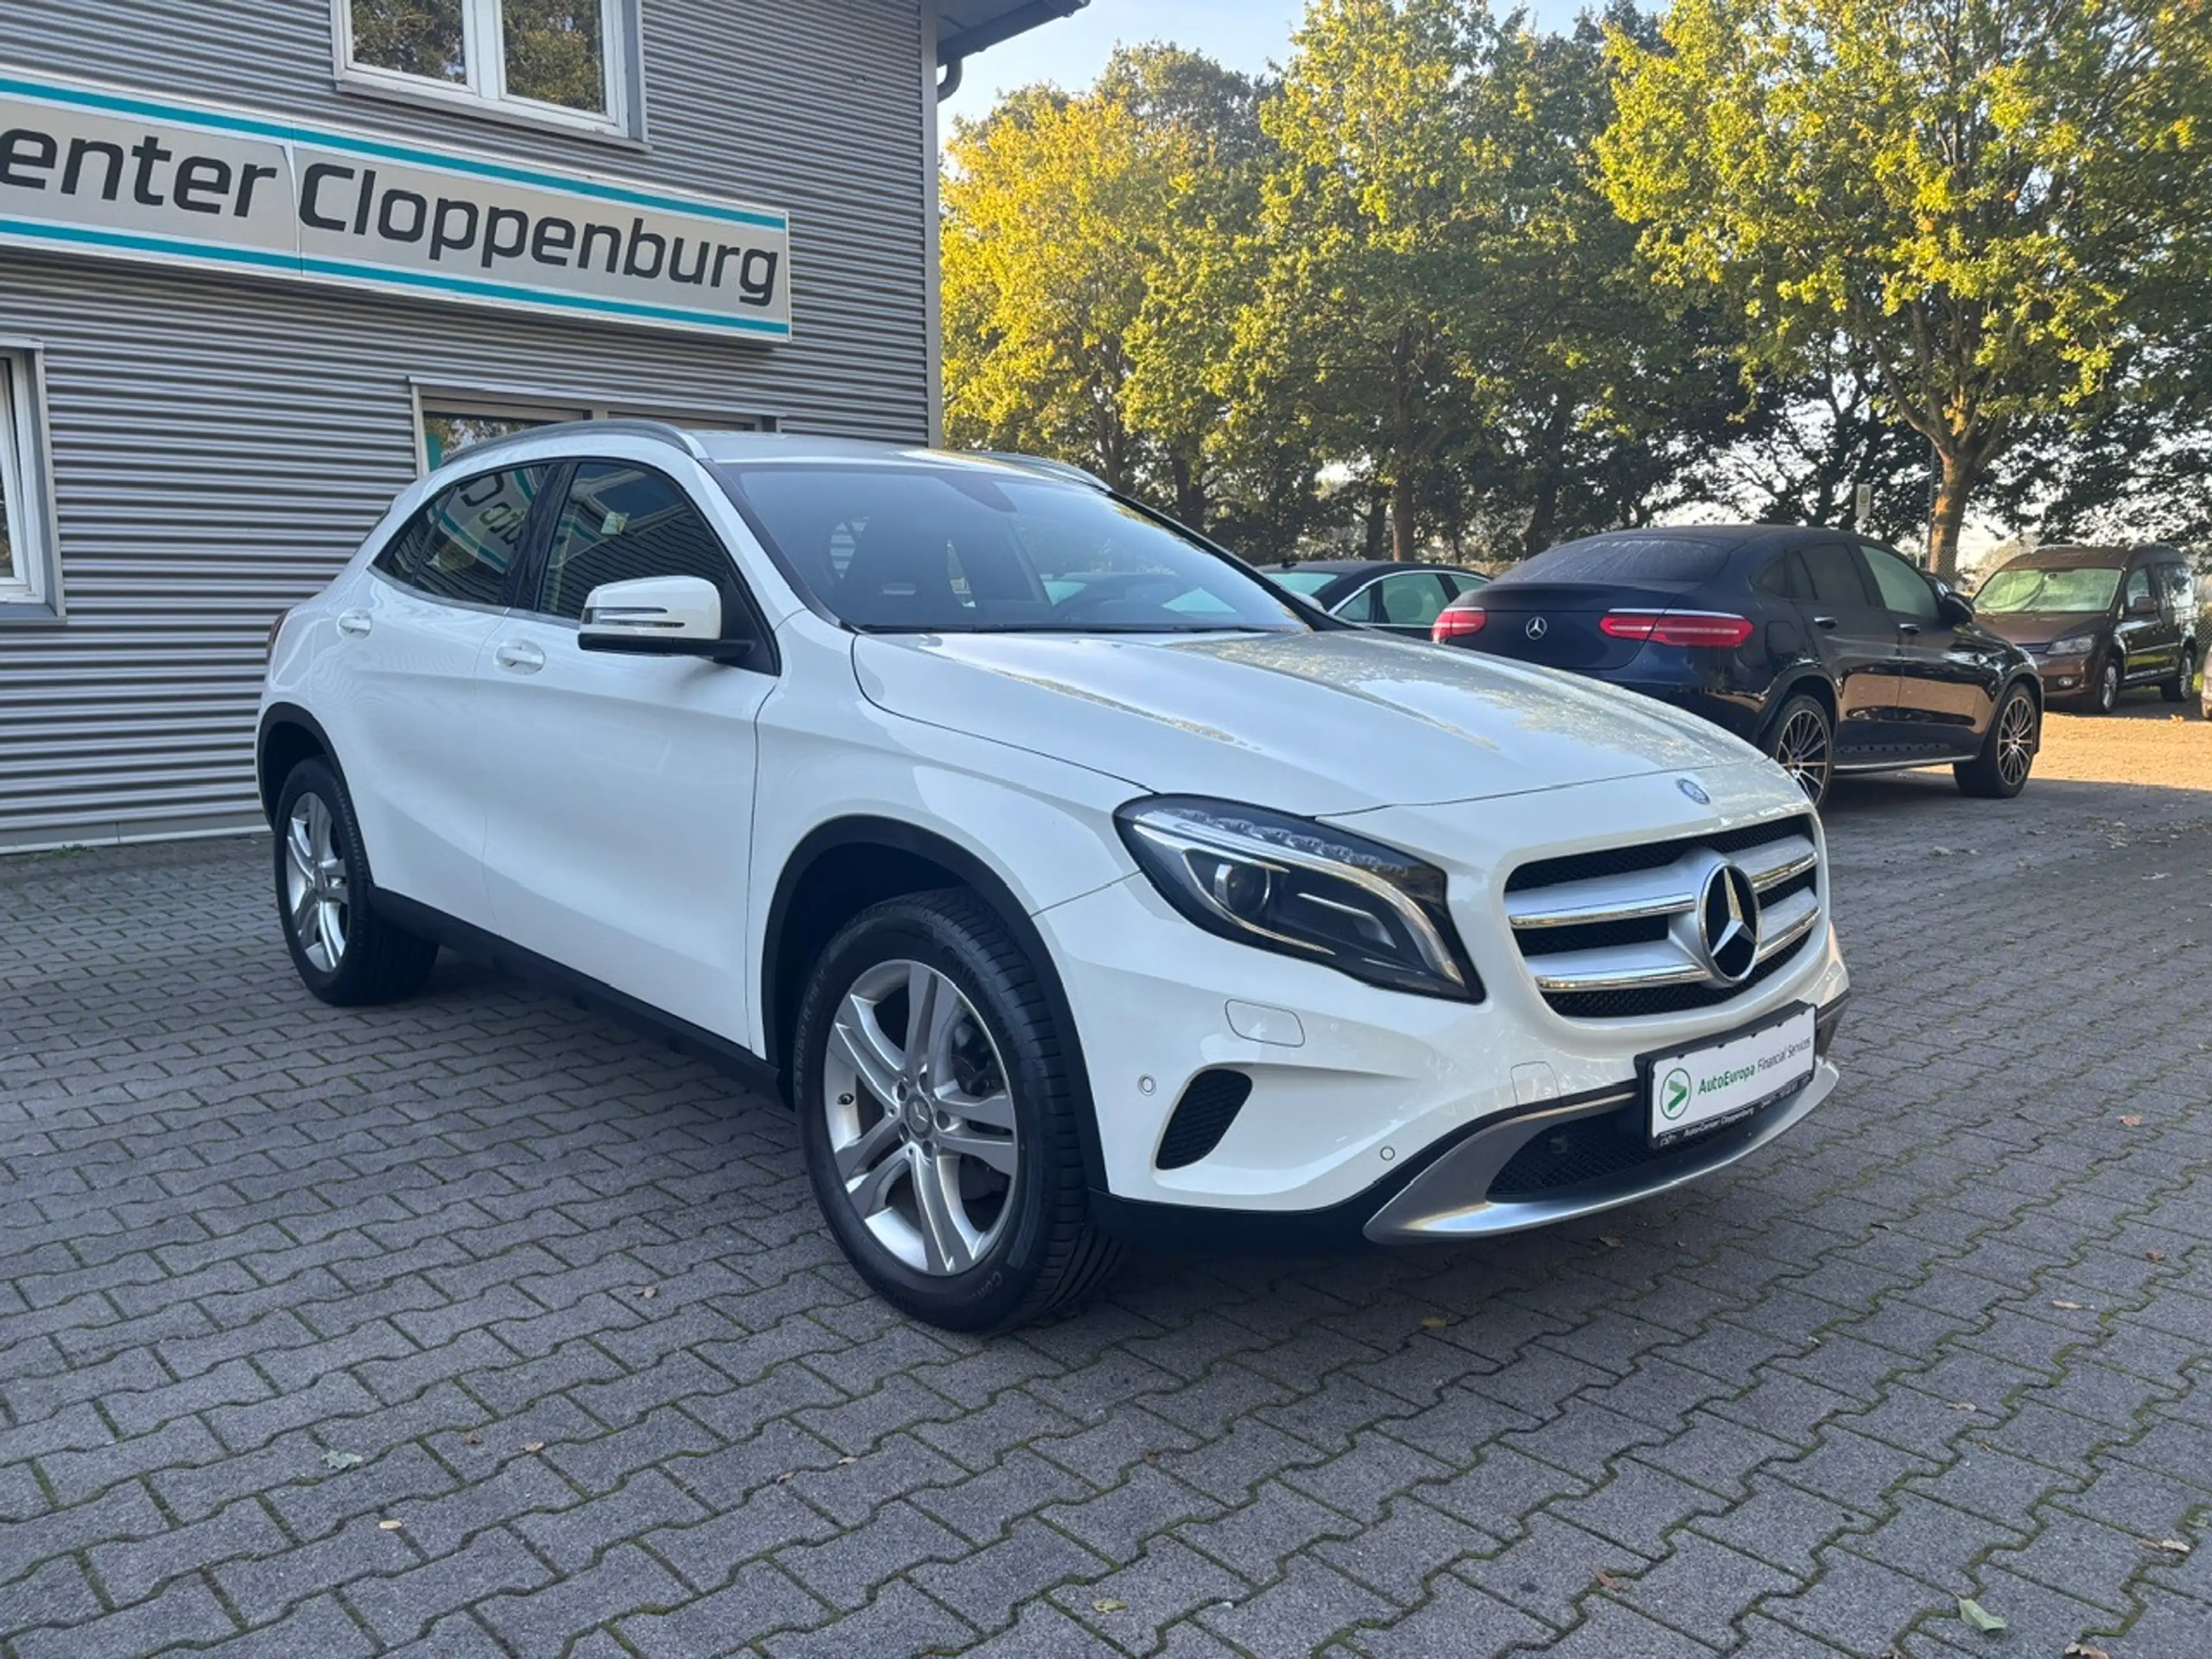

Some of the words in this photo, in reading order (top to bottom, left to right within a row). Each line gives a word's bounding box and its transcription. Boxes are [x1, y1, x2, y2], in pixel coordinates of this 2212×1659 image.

[298, 162, 778, 307] Cloppenburg
[1698, 1065, 1755, 1094] AutoEuropa
[1757, 1051, 1786, 1072] Financial
[1787, 1037, 1812, 1058] Services
